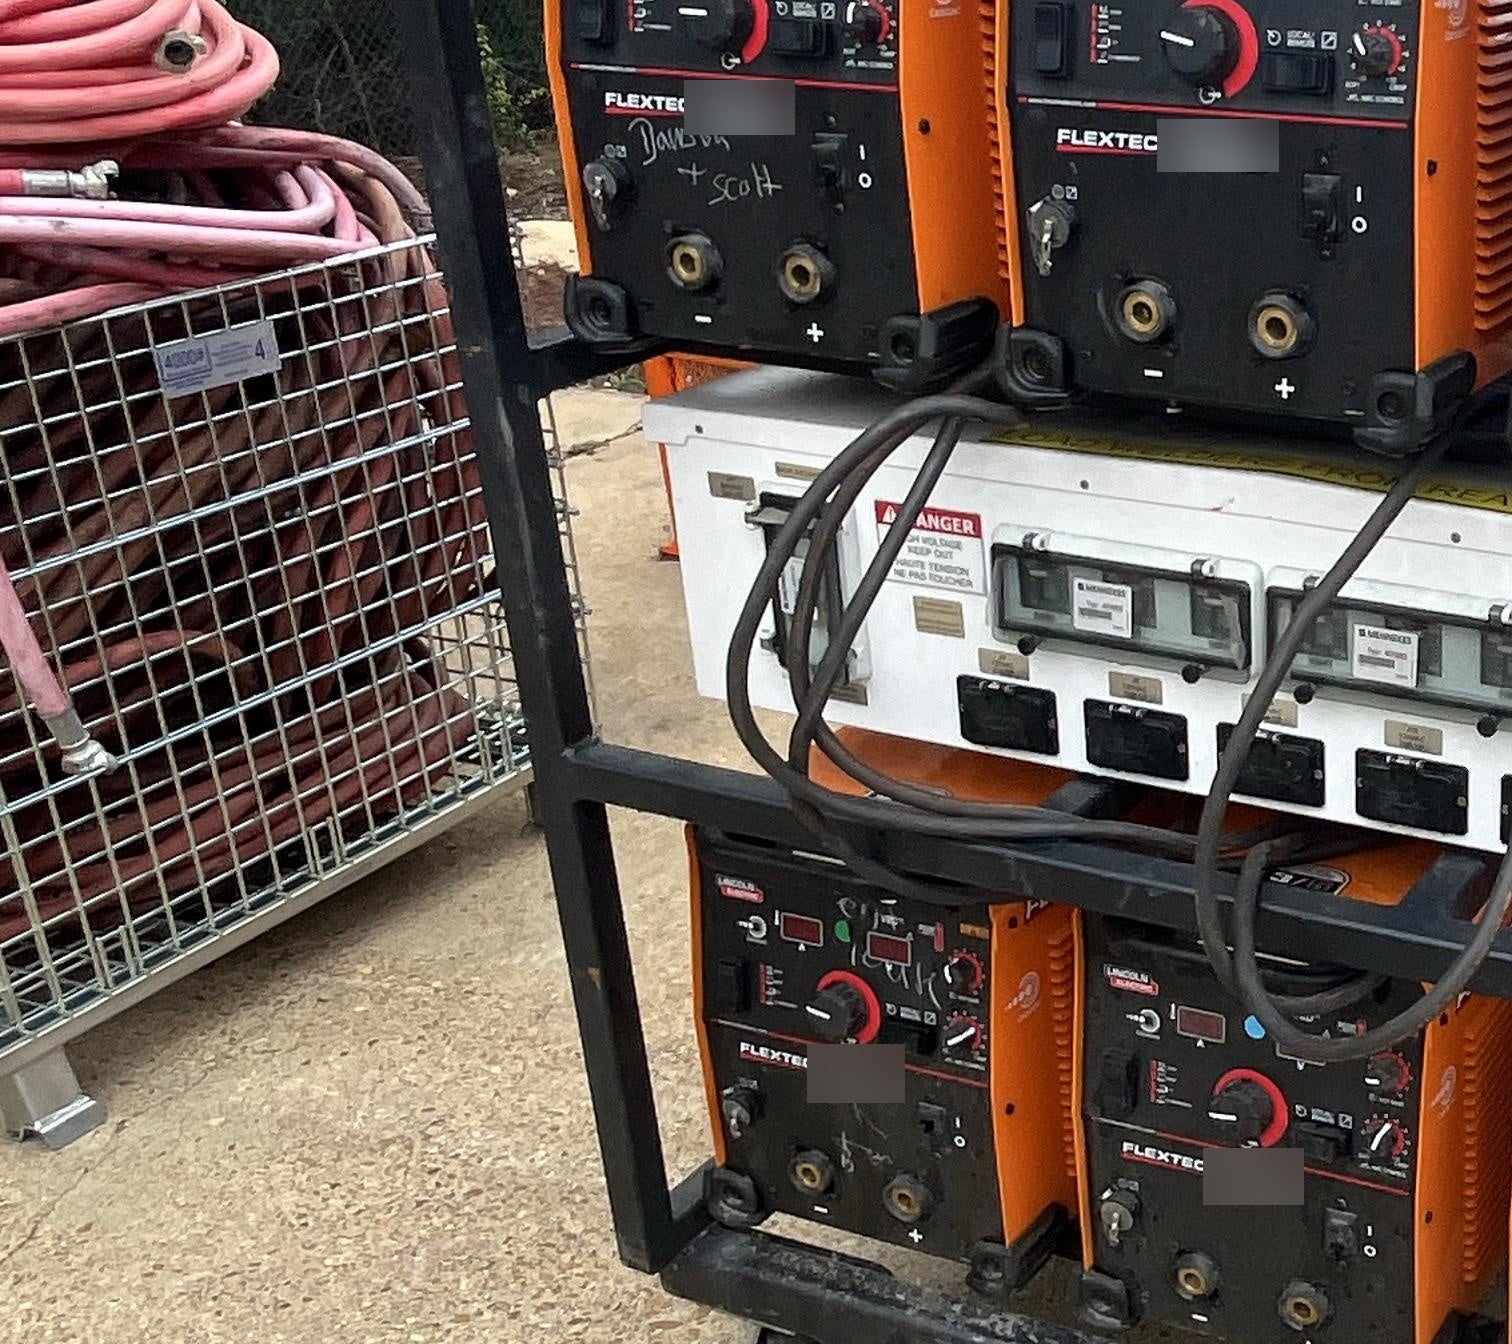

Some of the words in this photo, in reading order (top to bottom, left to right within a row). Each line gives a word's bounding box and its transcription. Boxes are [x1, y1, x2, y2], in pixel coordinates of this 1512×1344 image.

[1057, 128, 1158, 151] FLEXTEC
[917, 511, 976, 535] ANGER
[1122, 1141, 1203, 1172] FLEXTEC
